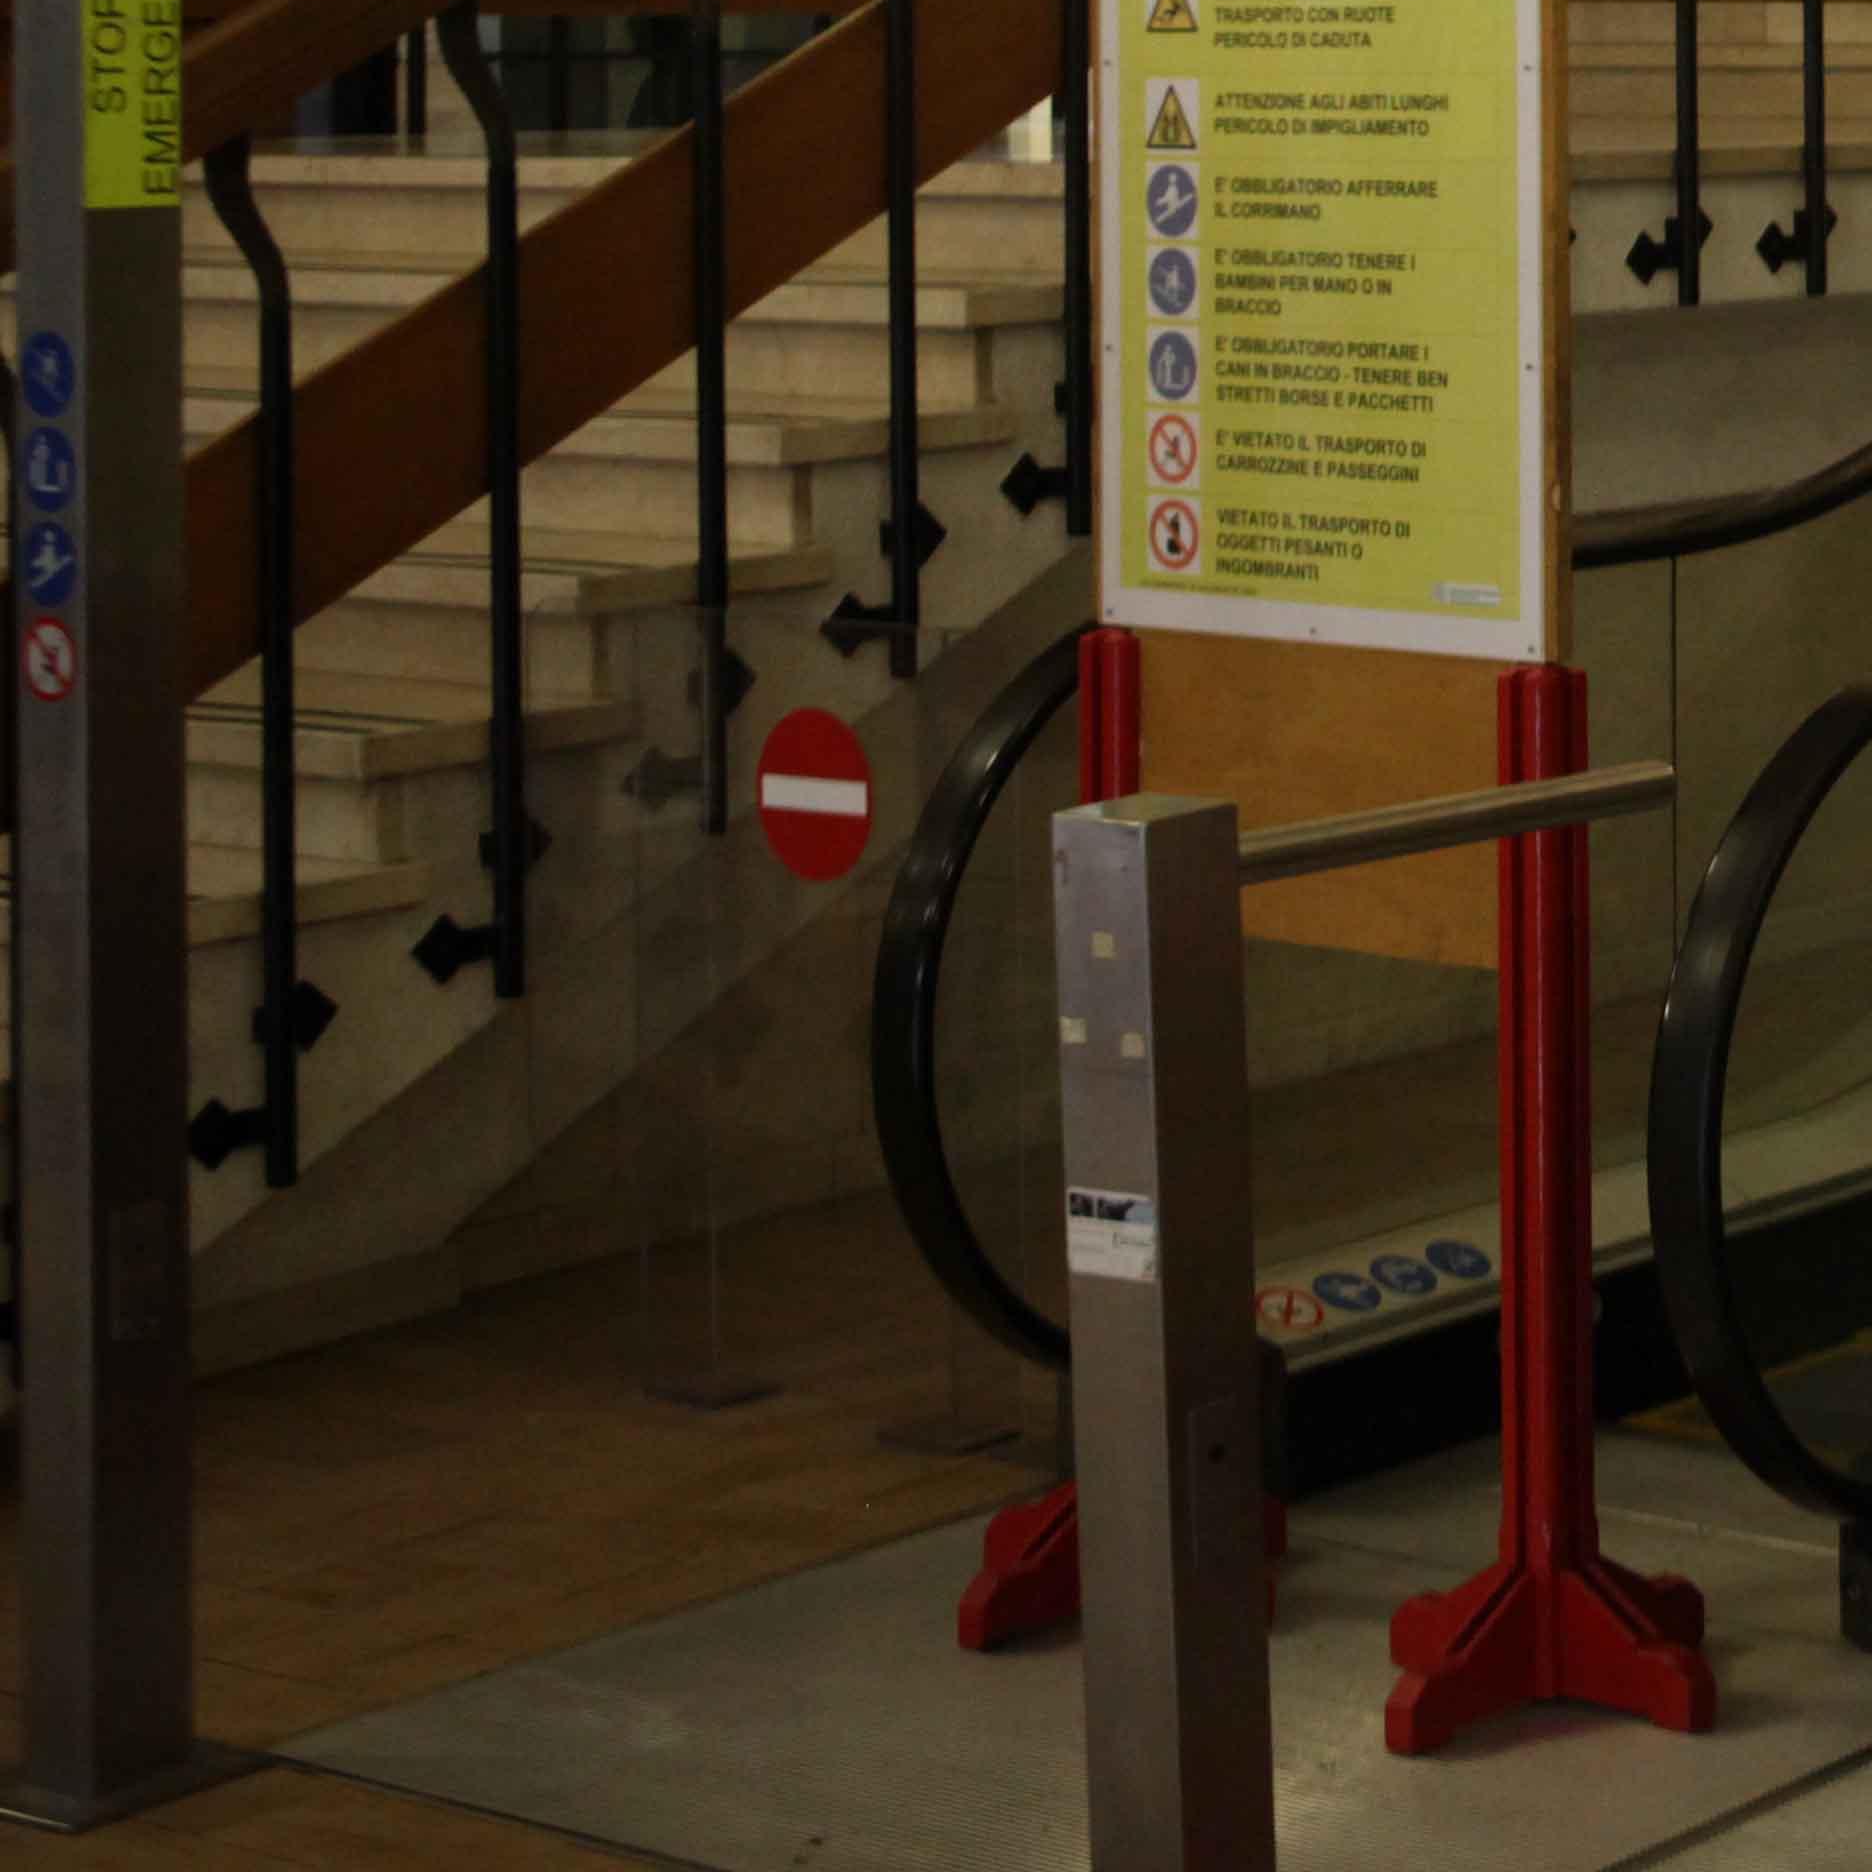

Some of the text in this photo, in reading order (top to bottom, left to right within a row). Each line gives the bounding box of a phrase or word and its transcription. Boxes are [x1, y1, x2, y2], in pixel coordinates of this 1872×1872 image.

[1215, 250, 1415, 270] E' OBBLIGATORIO TENERE I
[1215, 274, 1392, 295] BAMBINI PER MANO O IN
[1215, 298, 1281, 316] BRACCIO
[1216, 337, 1428, 361] E' OBBLIGATORIO PORTARE I
[1216, 361, 1448, 388] CANI IN BRACCIO TENERE BEN
[1216, 385, 1432, 413] STRETTI BORSE E PACCHETTI
[1216, 430, 1426, 458] E' VIETATO IL TRASPORTO DI
[1216, 455, 1420, 483] CARROZZINE E PASSEGGINI
[1217, 510, 1410, 538] VIETATO IL TRASPORTO DI
[1217, 534, 1362, 559] OGGETTI PESANTI O
[1216, 558, 1319, 581] INGOMBRANTI
